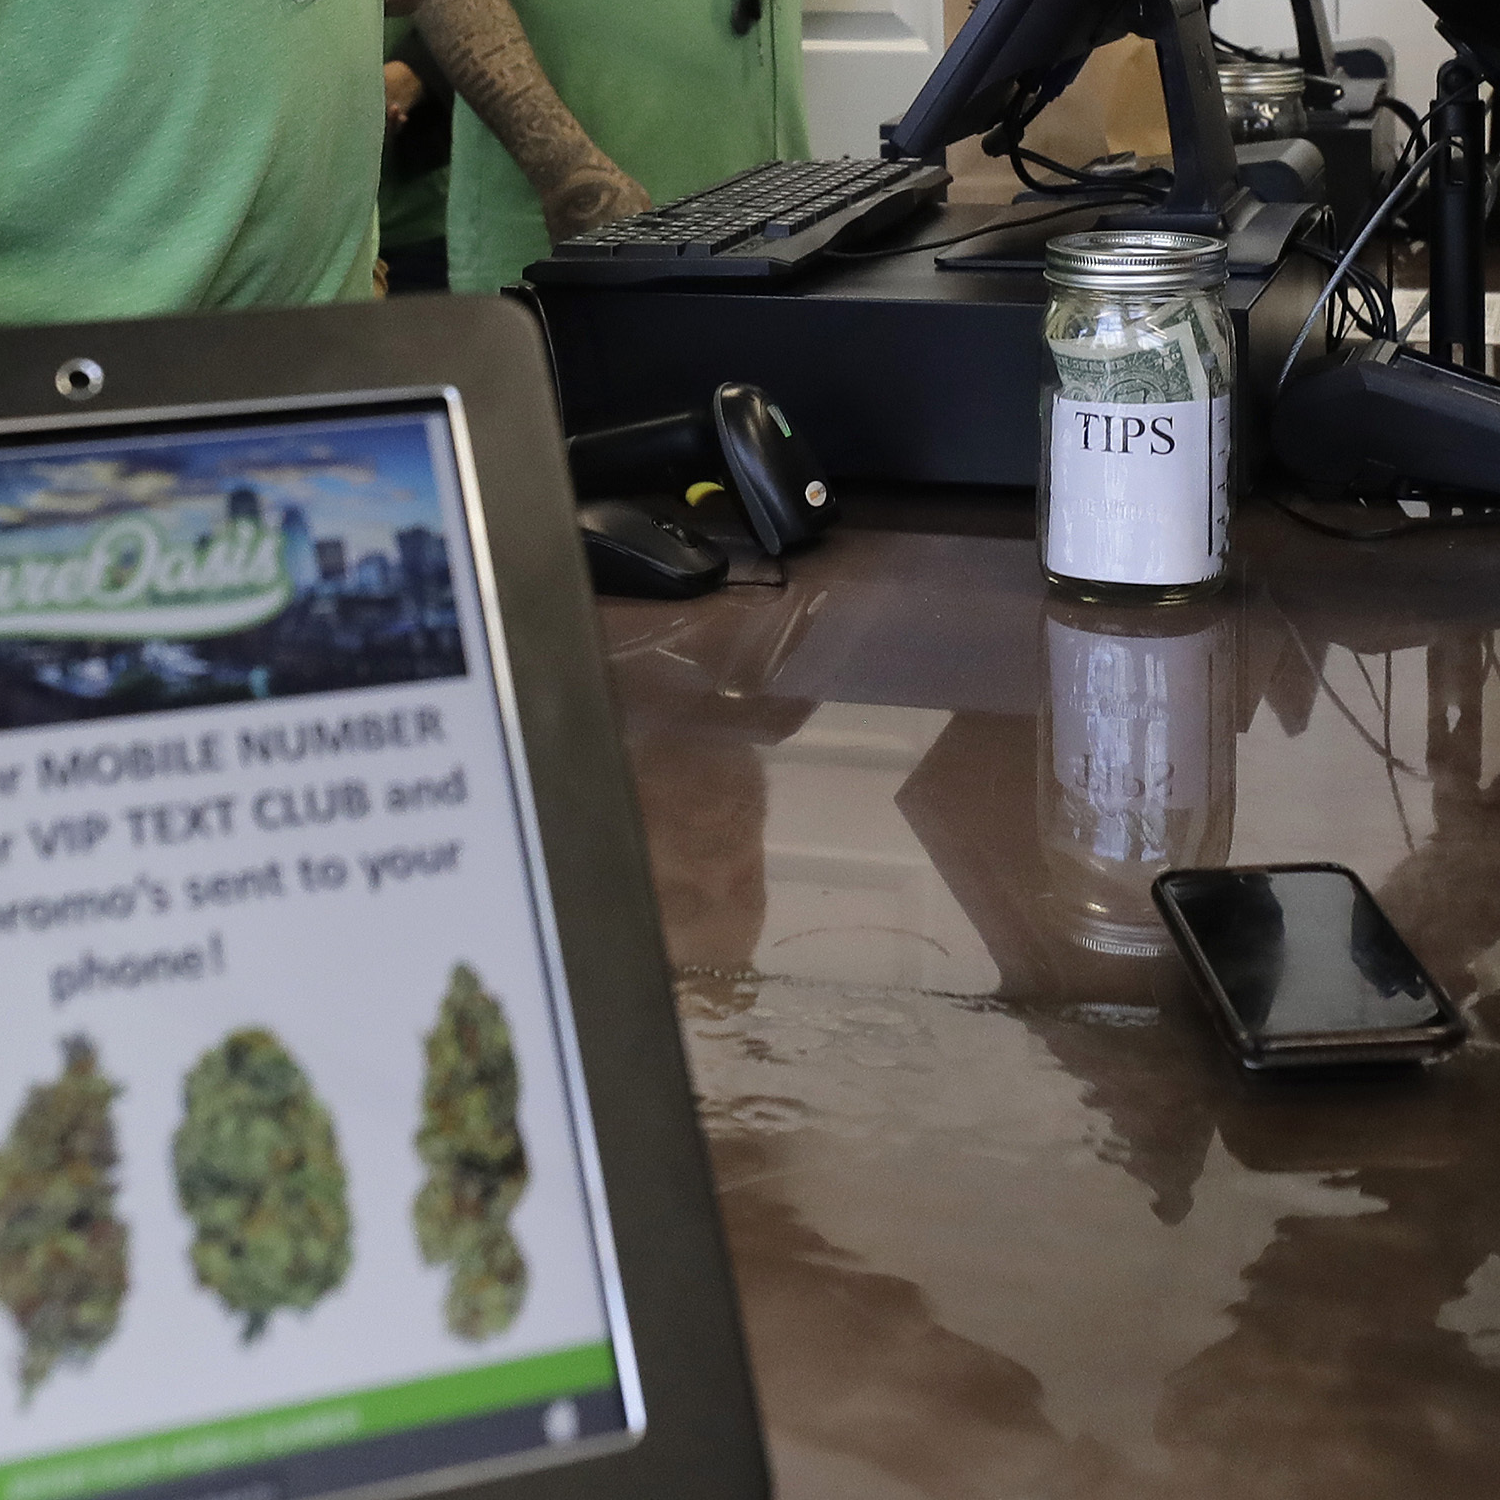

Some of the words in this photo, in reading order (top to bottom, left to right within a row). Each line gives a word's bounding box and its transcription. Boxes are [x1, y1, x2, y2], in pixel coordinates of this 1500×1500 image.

[1074, 411, 1176, 455] TIPS
[36, 730, 222, 789] MOBILE
[239, 705, 445, 766] NUMBER
[26, 810, 111, 860] VIP
[125, 790, 236, 849] TEXT
[251, 775, 373, 830] CLUB
[387, 761, 468, 810] and
[184, 857, 285, 911] sent
[297, 852, 350, 893] to
[358, 837, 463, 897] your
[50, 930, 228, 1007] phone!
